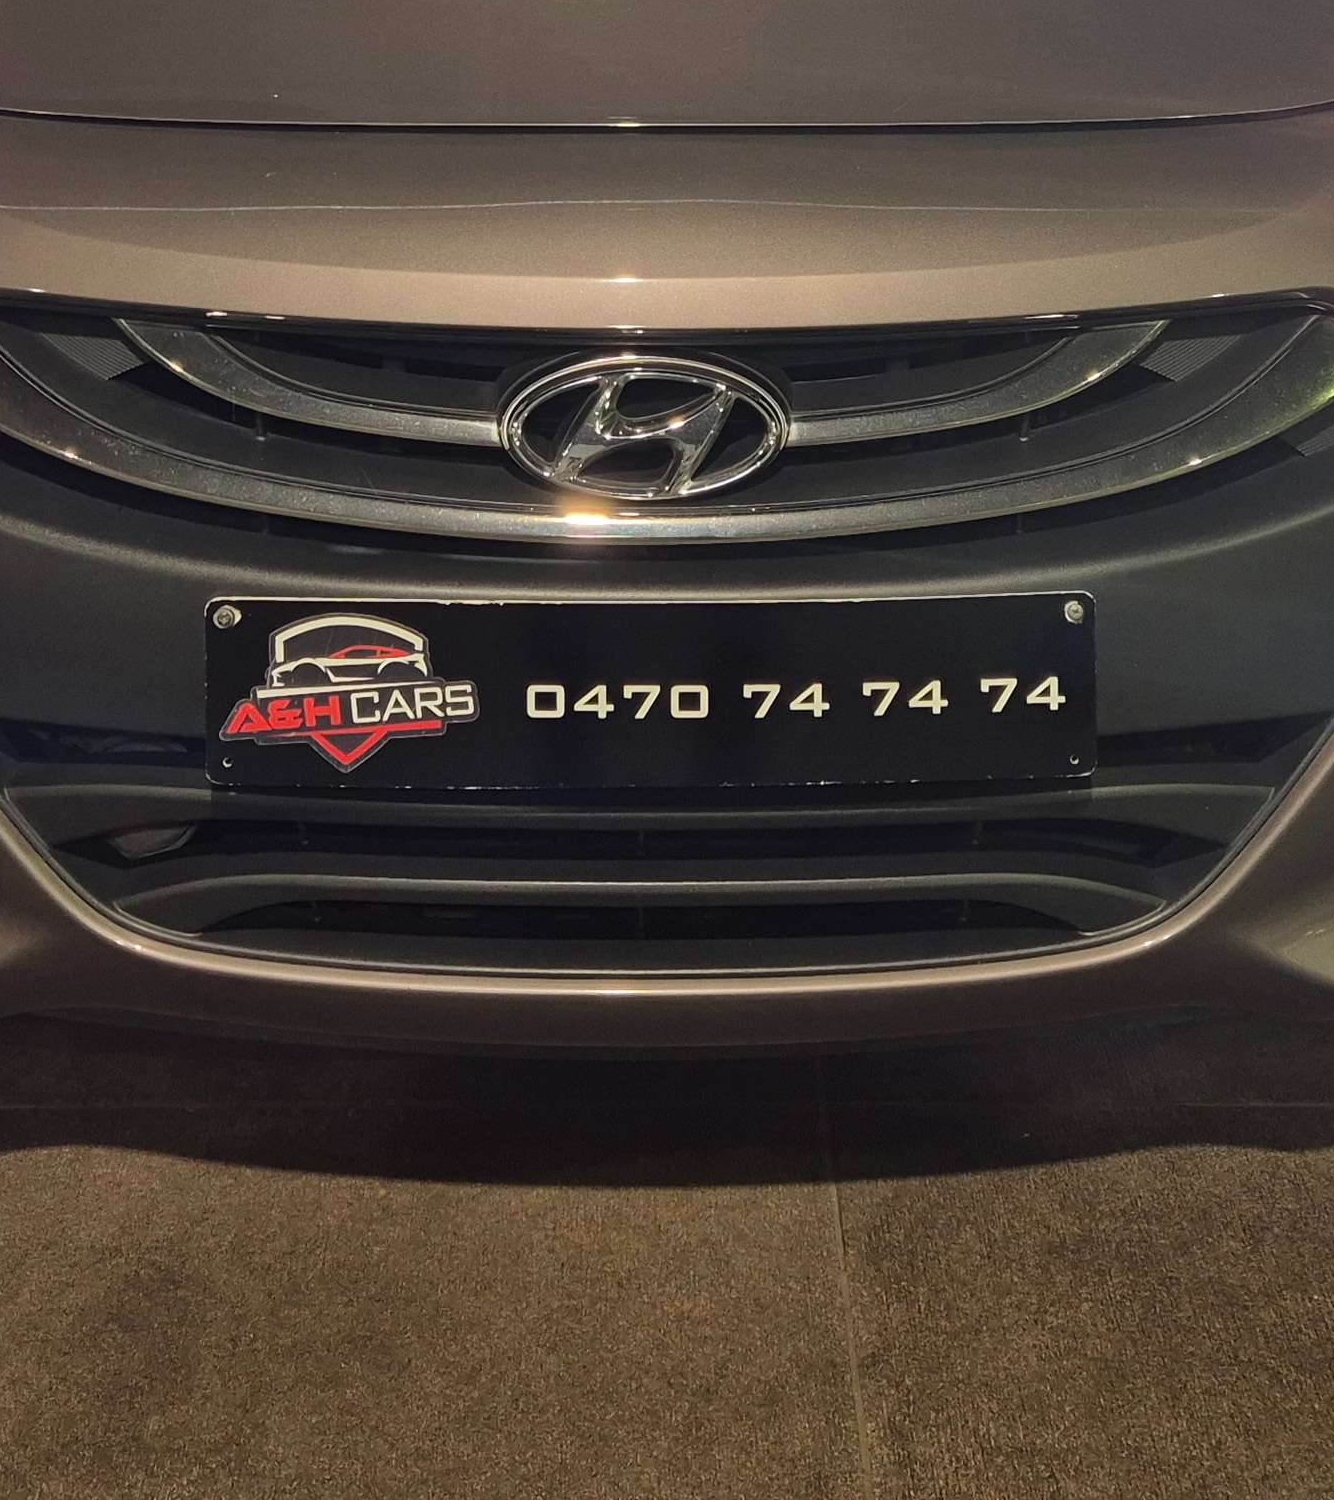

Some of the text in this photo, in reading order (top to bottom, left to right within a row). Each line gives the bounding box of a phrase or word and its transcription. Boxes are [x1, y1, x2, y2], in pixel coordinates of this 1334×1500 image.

[226, 684, 475, 734] A&H CARS
[526, 676, 1067, 720] 0470 74 74 74
